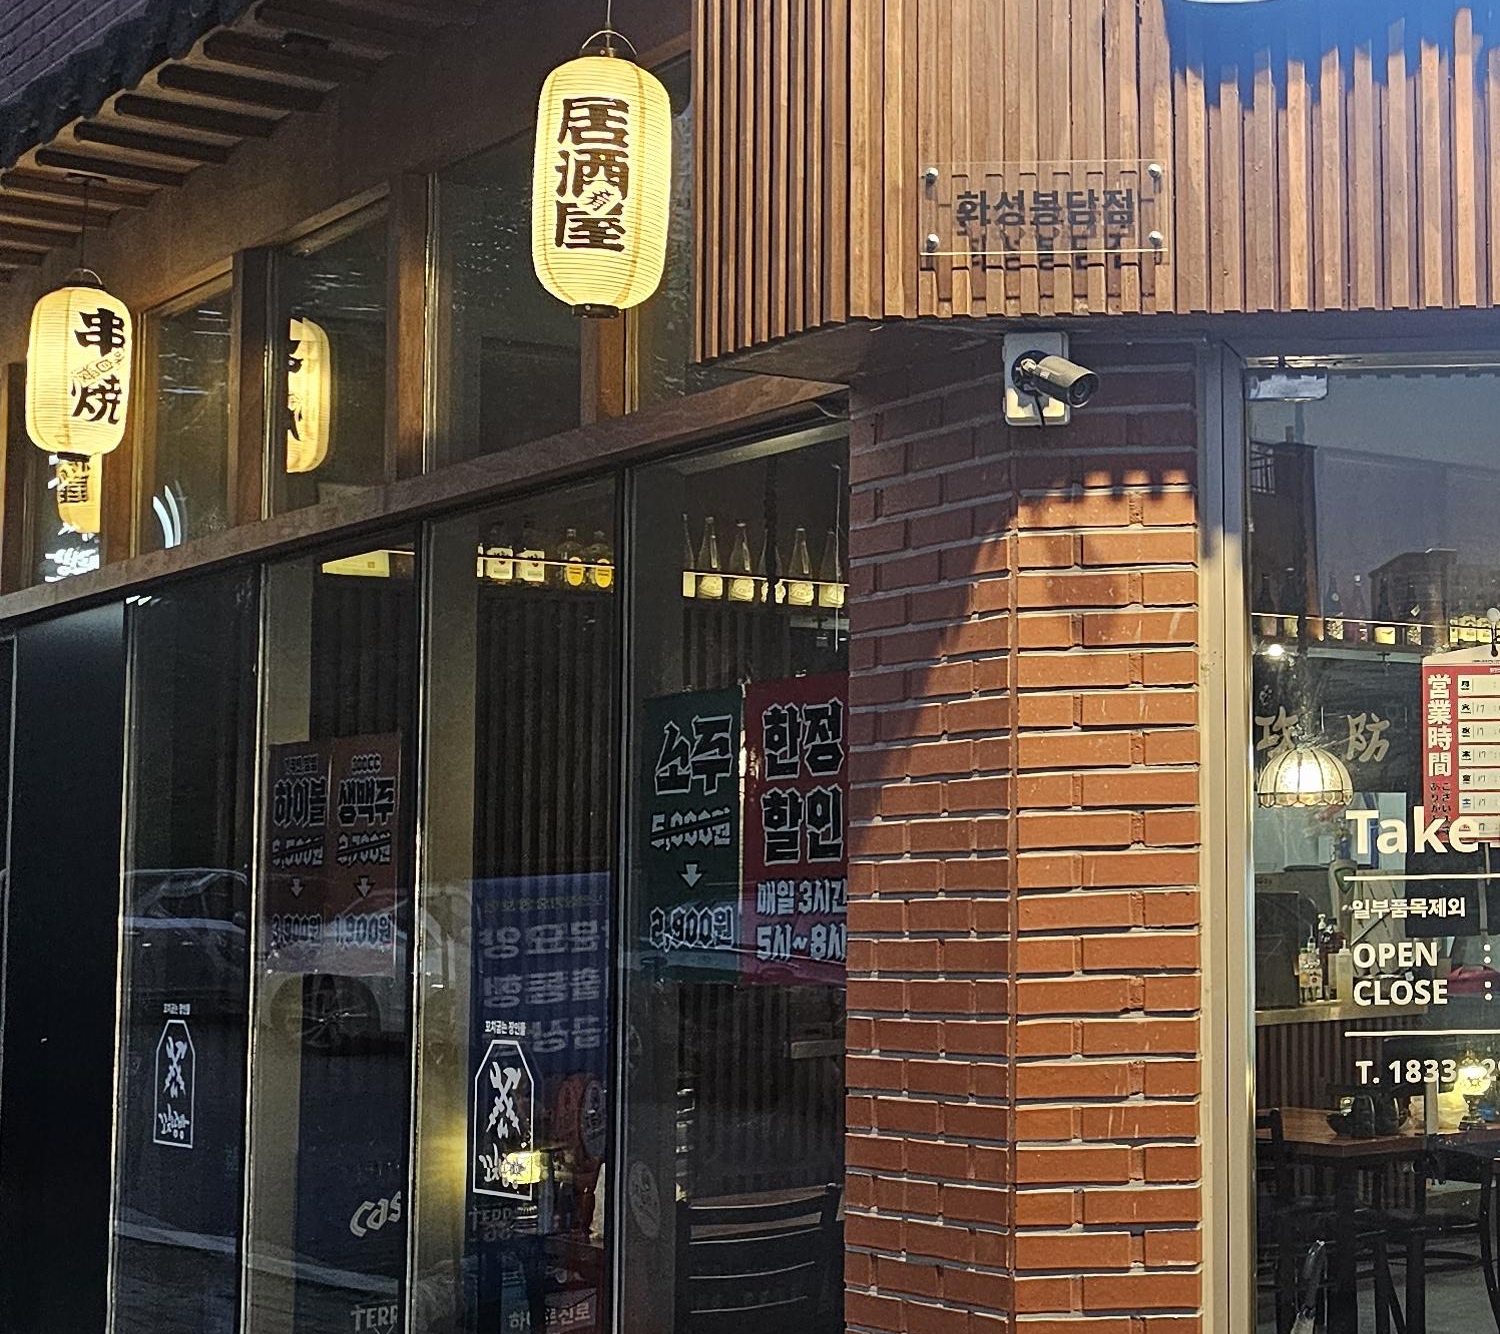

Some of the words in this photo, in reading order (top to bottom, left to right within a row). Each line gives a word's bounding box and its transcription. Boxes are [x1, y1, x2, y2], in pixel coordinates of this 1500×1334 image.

[956, 189, 1135, 227] 화성봉담점
[762, 696, 844, 782] 한정
[1428, 673, 1452, 777] 営業時間
[654, 714, 733, 796] 소주
[272, 772, 328, 829] 하이볼
[337, 775, 396, 828] 생맥주
[761, 783, 844, 867] 할인
[1345, 805, 1479, 855] Take
[757, 880, 794, 916] 매일
[798, 878, 847, 915] 3시간
[1352, 896, 1466, 920] 일부품목제외
[650, 906, 734, 953] 2,900원
[1353, 942, 1438, 968] OPEN
[1353, 980, 1448, 1006] CLOSE
[350, 1304, 398, 1332] TERR
